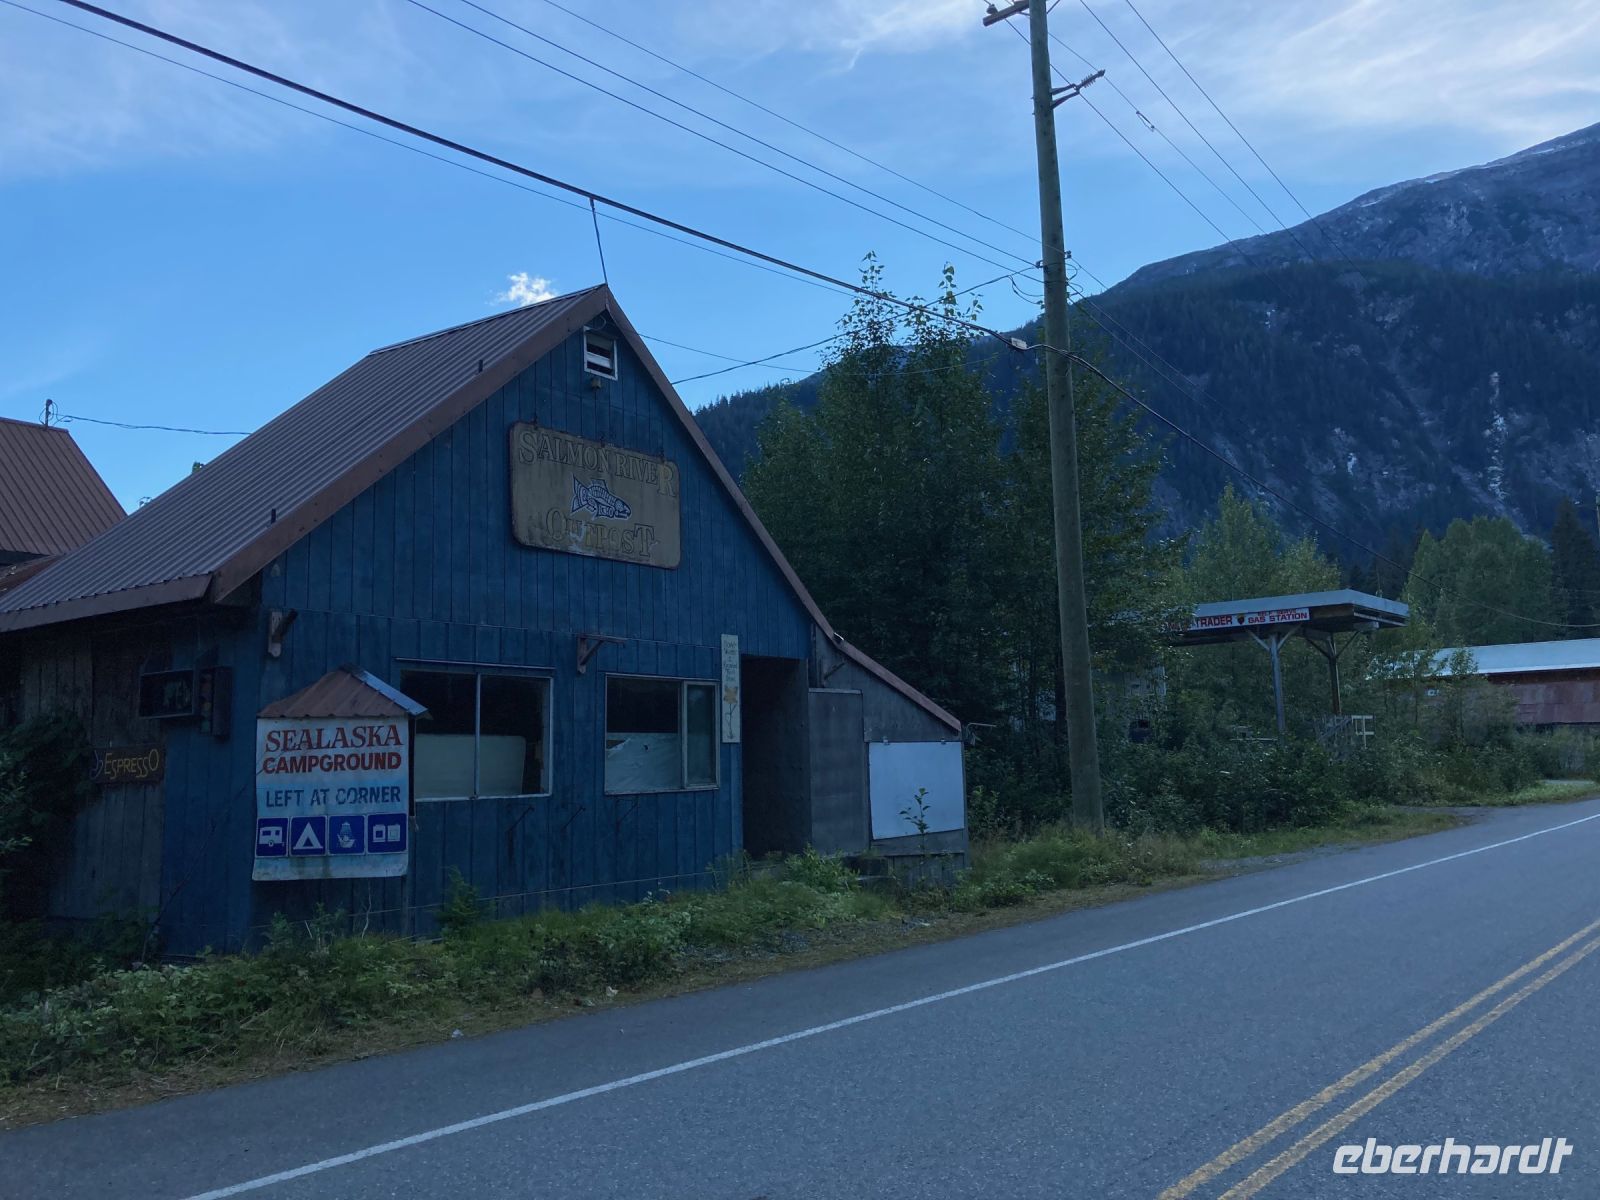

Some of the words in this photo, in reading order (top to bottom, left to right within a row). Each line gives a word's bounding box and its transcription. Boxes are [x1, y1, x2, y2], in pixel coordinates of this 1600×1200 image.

[519, 430, 609, 473] SALMON
[615, 453, 676, 497] RIVER
[545, 507, 655, 557] OUTPOST
[1248, 615, 1266, 624] GAS
[1269, 611, 1308, 623] STATION
[265, 724, 404, 753] SEALASKA
[104, 748, 159, 780] ESPRESSO
[263, 752, 402, 775] CAMPGROUND
[266, 789, 304, 808] LEFT
[310, 788, 330, 806] AT
[336, 786, 401, 805] CORNER
